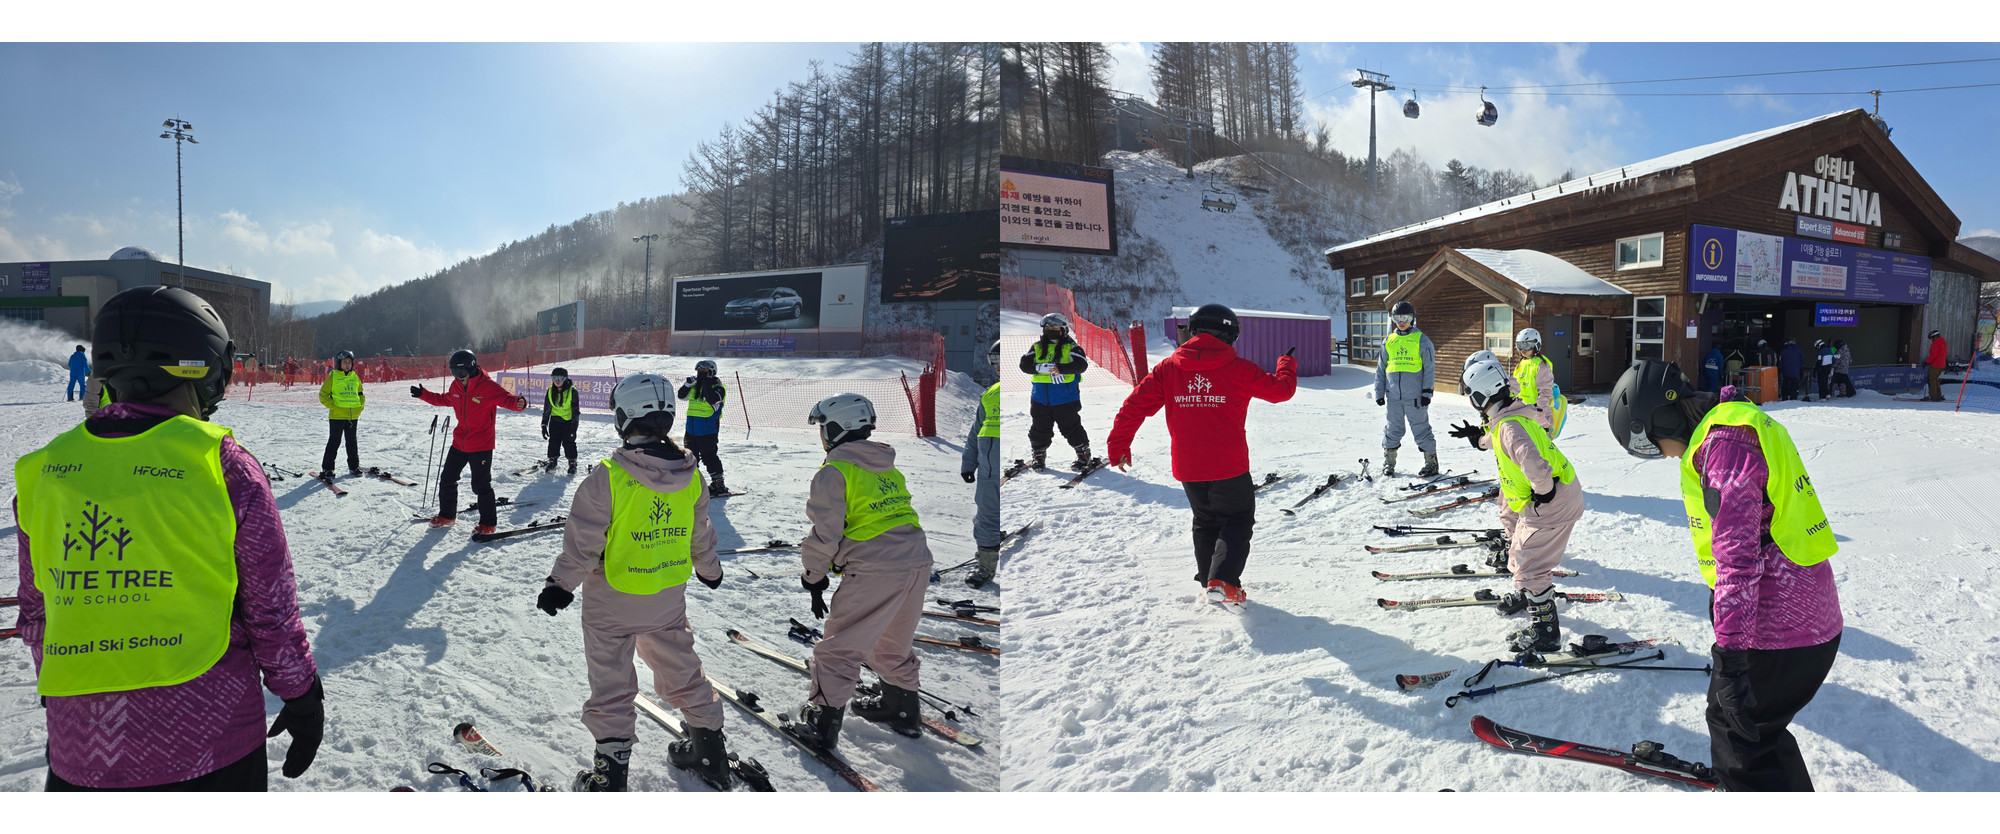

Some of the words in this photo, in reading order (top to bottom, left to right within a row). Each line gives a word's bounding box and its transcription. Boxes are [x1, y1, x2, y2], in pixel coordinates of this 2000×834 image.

[1815, 154, 1855, 186] 아테나
[1000, 191, 1020, 201] 화재
[1023, 193, 1051, 203] 예방을
[1055, 196, 1082, 206] 위하여
[1778, 171, 1882, 227] ATHENA
[1001, 203, 1030, 213] 지정된
[1034, 206, 1071, 217] 흡연장소
[1002, 216, 1031, 226] 이외의
[1034, 218, 1062, 229] 흡연을
[1799, 220, 1817, 232] Expert
[1834, 226, 1857, 238] Advanced
[1696, 273, 1728, 282] INFORMATION
[518, 378, 544, 390] 어린이
[1174, 395, 1201, 403] WHITE
[133, 465, 185, 480] HFORCE
[662, 527, 687, 537] TREE
[641, 541, 655, 549] SNO
[661, 561, 669, 569] Ski
[670, 558, 687, 567] School
[106, 570, 173, 588] TREE
[84, 593, 151, 605] SCHOOL
[99, 639, 124, 652] Ski
[128, 633, 182, 650] School
